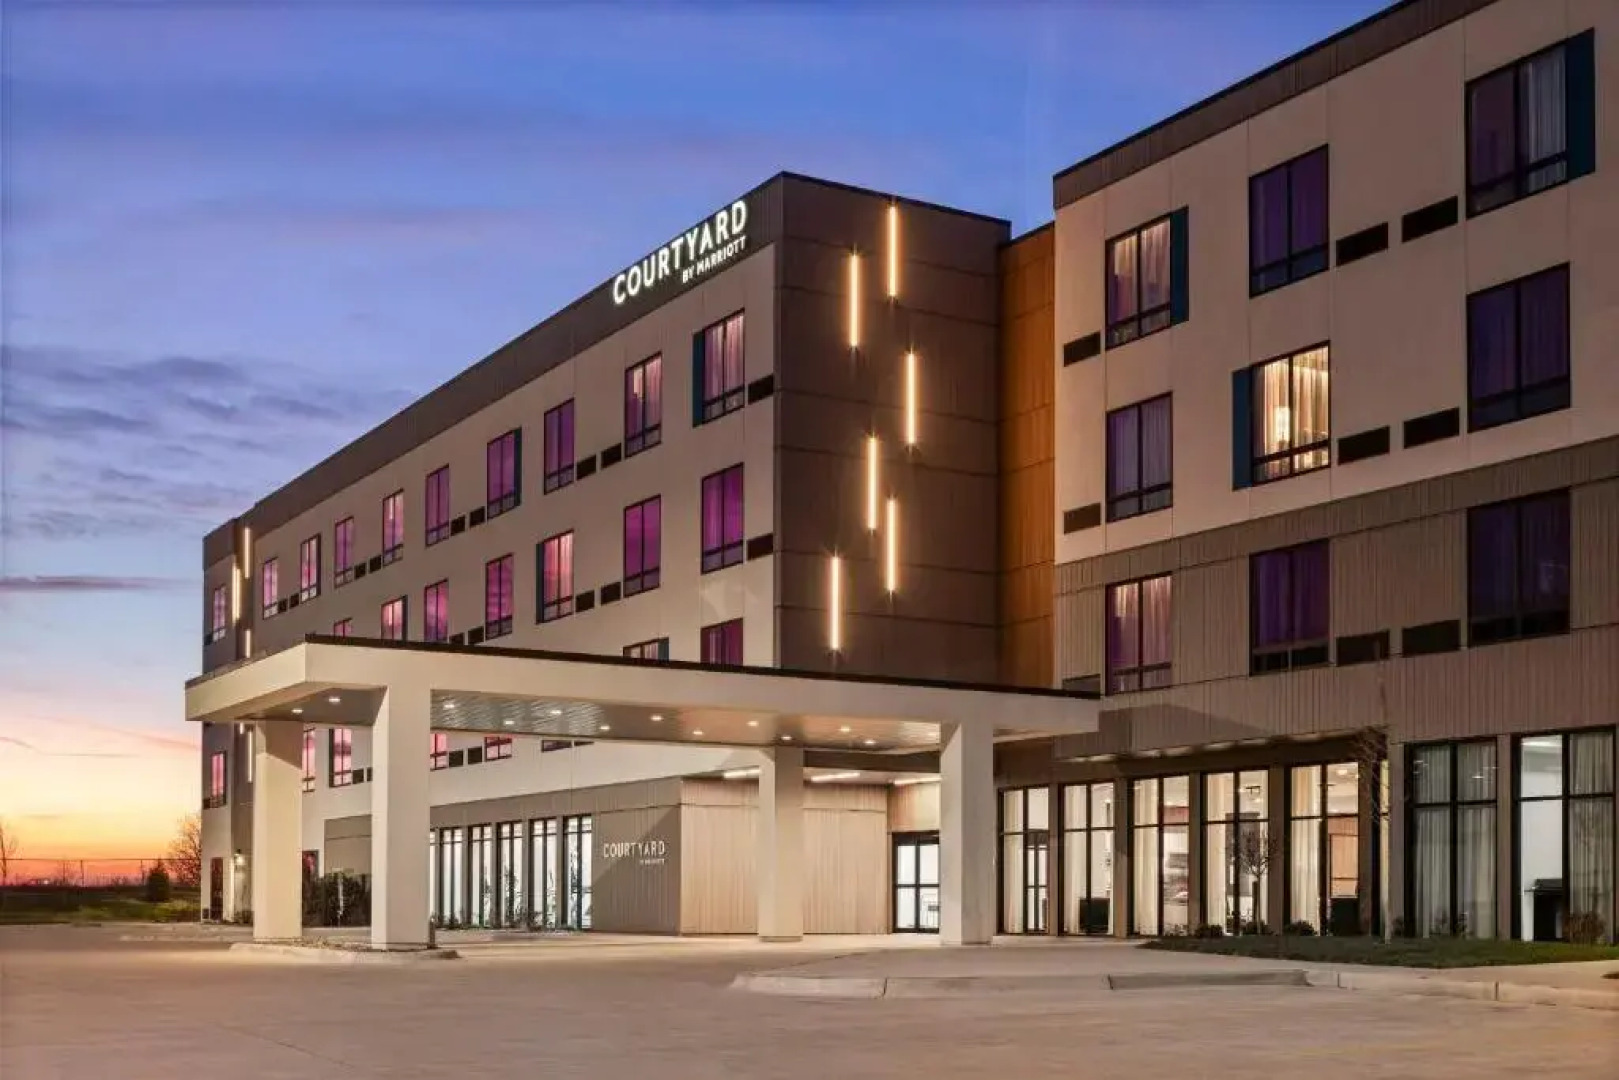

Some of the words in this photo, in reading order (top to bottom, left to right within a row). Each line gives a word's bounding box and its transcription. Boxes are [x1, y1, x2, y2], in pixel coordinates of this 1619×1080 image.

[613, 200, 747, 304] COURTYARD
[682, 265, 695, 284] BY
[697, 235, 747, 275] MARRIOTT
[603, 840, 665, 858] COURTYARD
